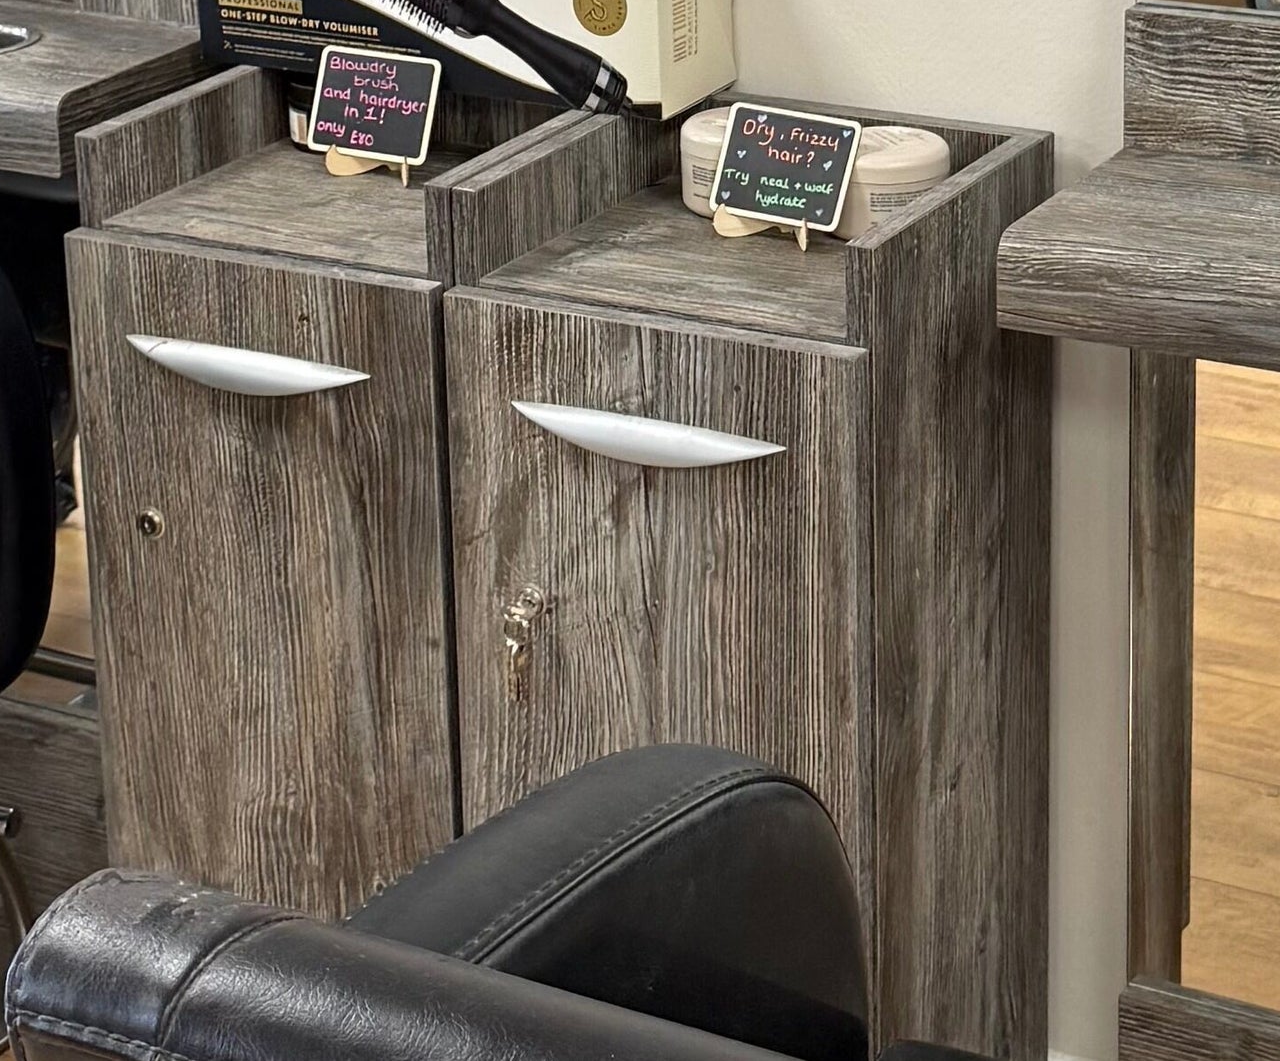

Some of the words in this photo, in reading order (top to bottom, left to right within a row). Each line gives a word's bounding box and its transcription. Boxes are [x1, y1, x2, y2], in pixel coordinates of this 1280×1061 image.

[220, 8, 267, 22] ONE-STEP
[269, 14, 320, 29] BLOW-DRY
[323, 21, 379, 36] VOLUMISER
[673, 35, 687, 63] HOT
[330, 56, 397, 80] Blowdry
[354, 75, 399, 91] brush
[323, 87, 351, 100] and
[359, 89, 427, 115] hairdryer
[317, 120, 346, 137] only
[724, 168, 750, 186] Try
[760, 176, 790, 190] neal
[794, 182, 802, 190] +
[804, 183, 834, 195] wolf
[755, 189, 807, 208] hydrate
